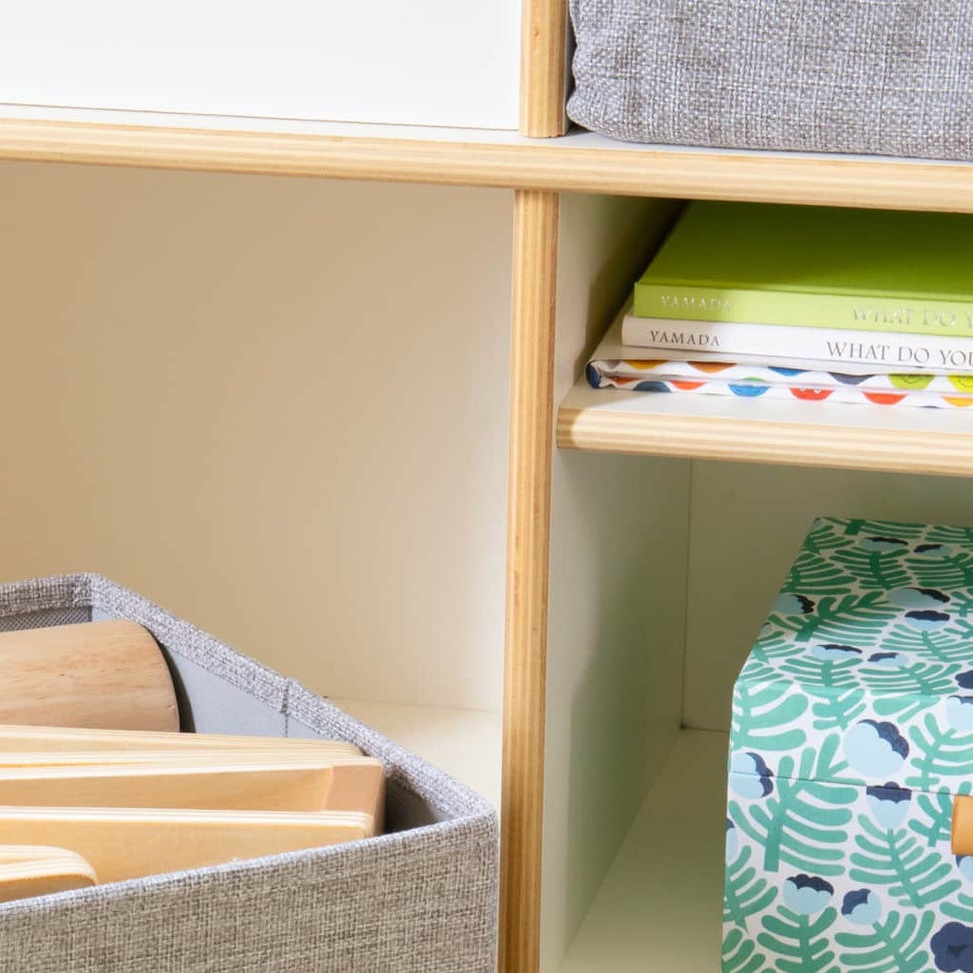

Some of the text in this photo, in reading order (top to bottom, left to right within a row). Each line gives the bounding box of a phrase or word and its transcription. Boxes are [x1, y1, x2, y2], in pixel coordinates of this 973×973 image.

[661, 295, 731, 312] YAMADA
[852, 304, 914, 325] WHAT
[923, 308, 957, 328] DO
[650, 330, 720, 347] YAMADA
[827, 341, 890, 361] WHAT
[898, 346, 930, 363] DO
